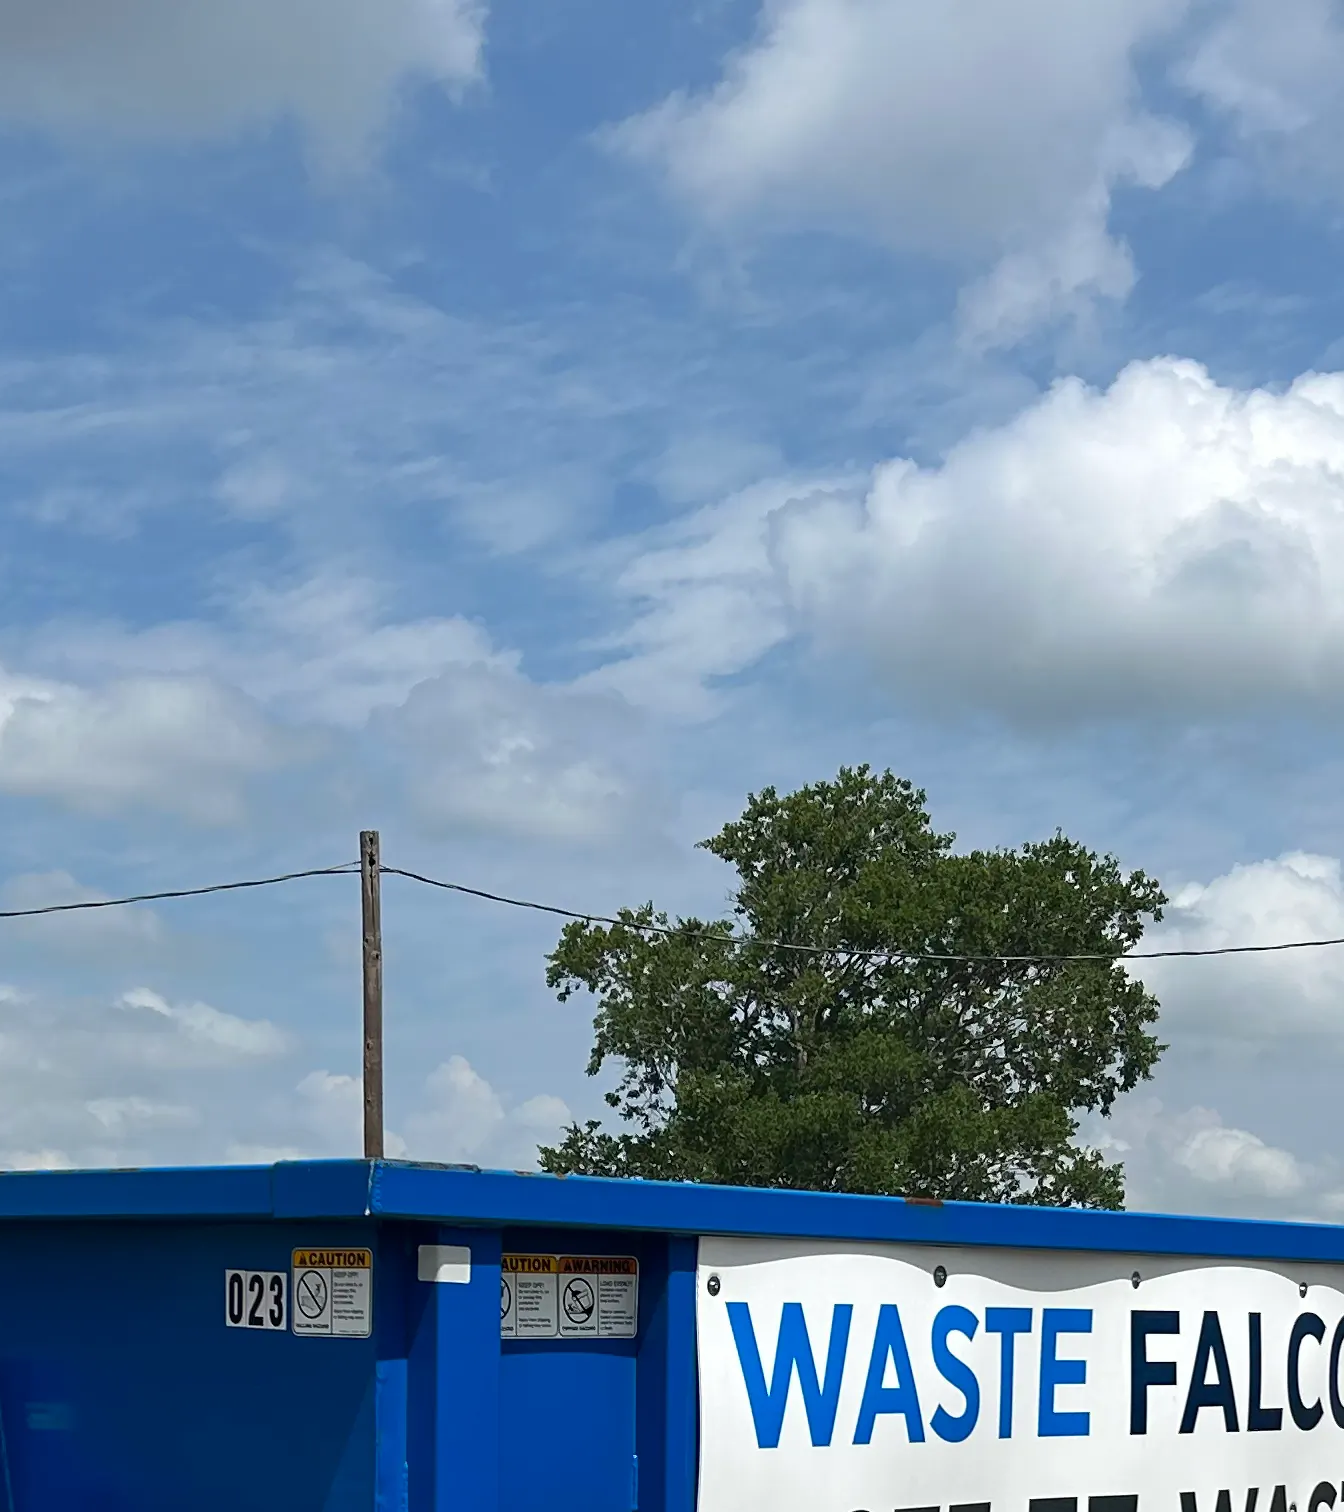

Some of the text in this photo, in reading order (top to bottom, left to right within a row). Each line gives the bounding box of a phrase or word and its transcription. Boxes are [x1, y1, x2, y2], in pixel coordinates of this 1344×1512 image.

[309, 1252, 365, 1266] CAUTION
[502, 1258, 551, 1272] AUTION
[573, 1259, 630, 1273] WARNING
[229, 1273, 283, 1327] 023
[725, 1301, 1093, 1449] WASTE
